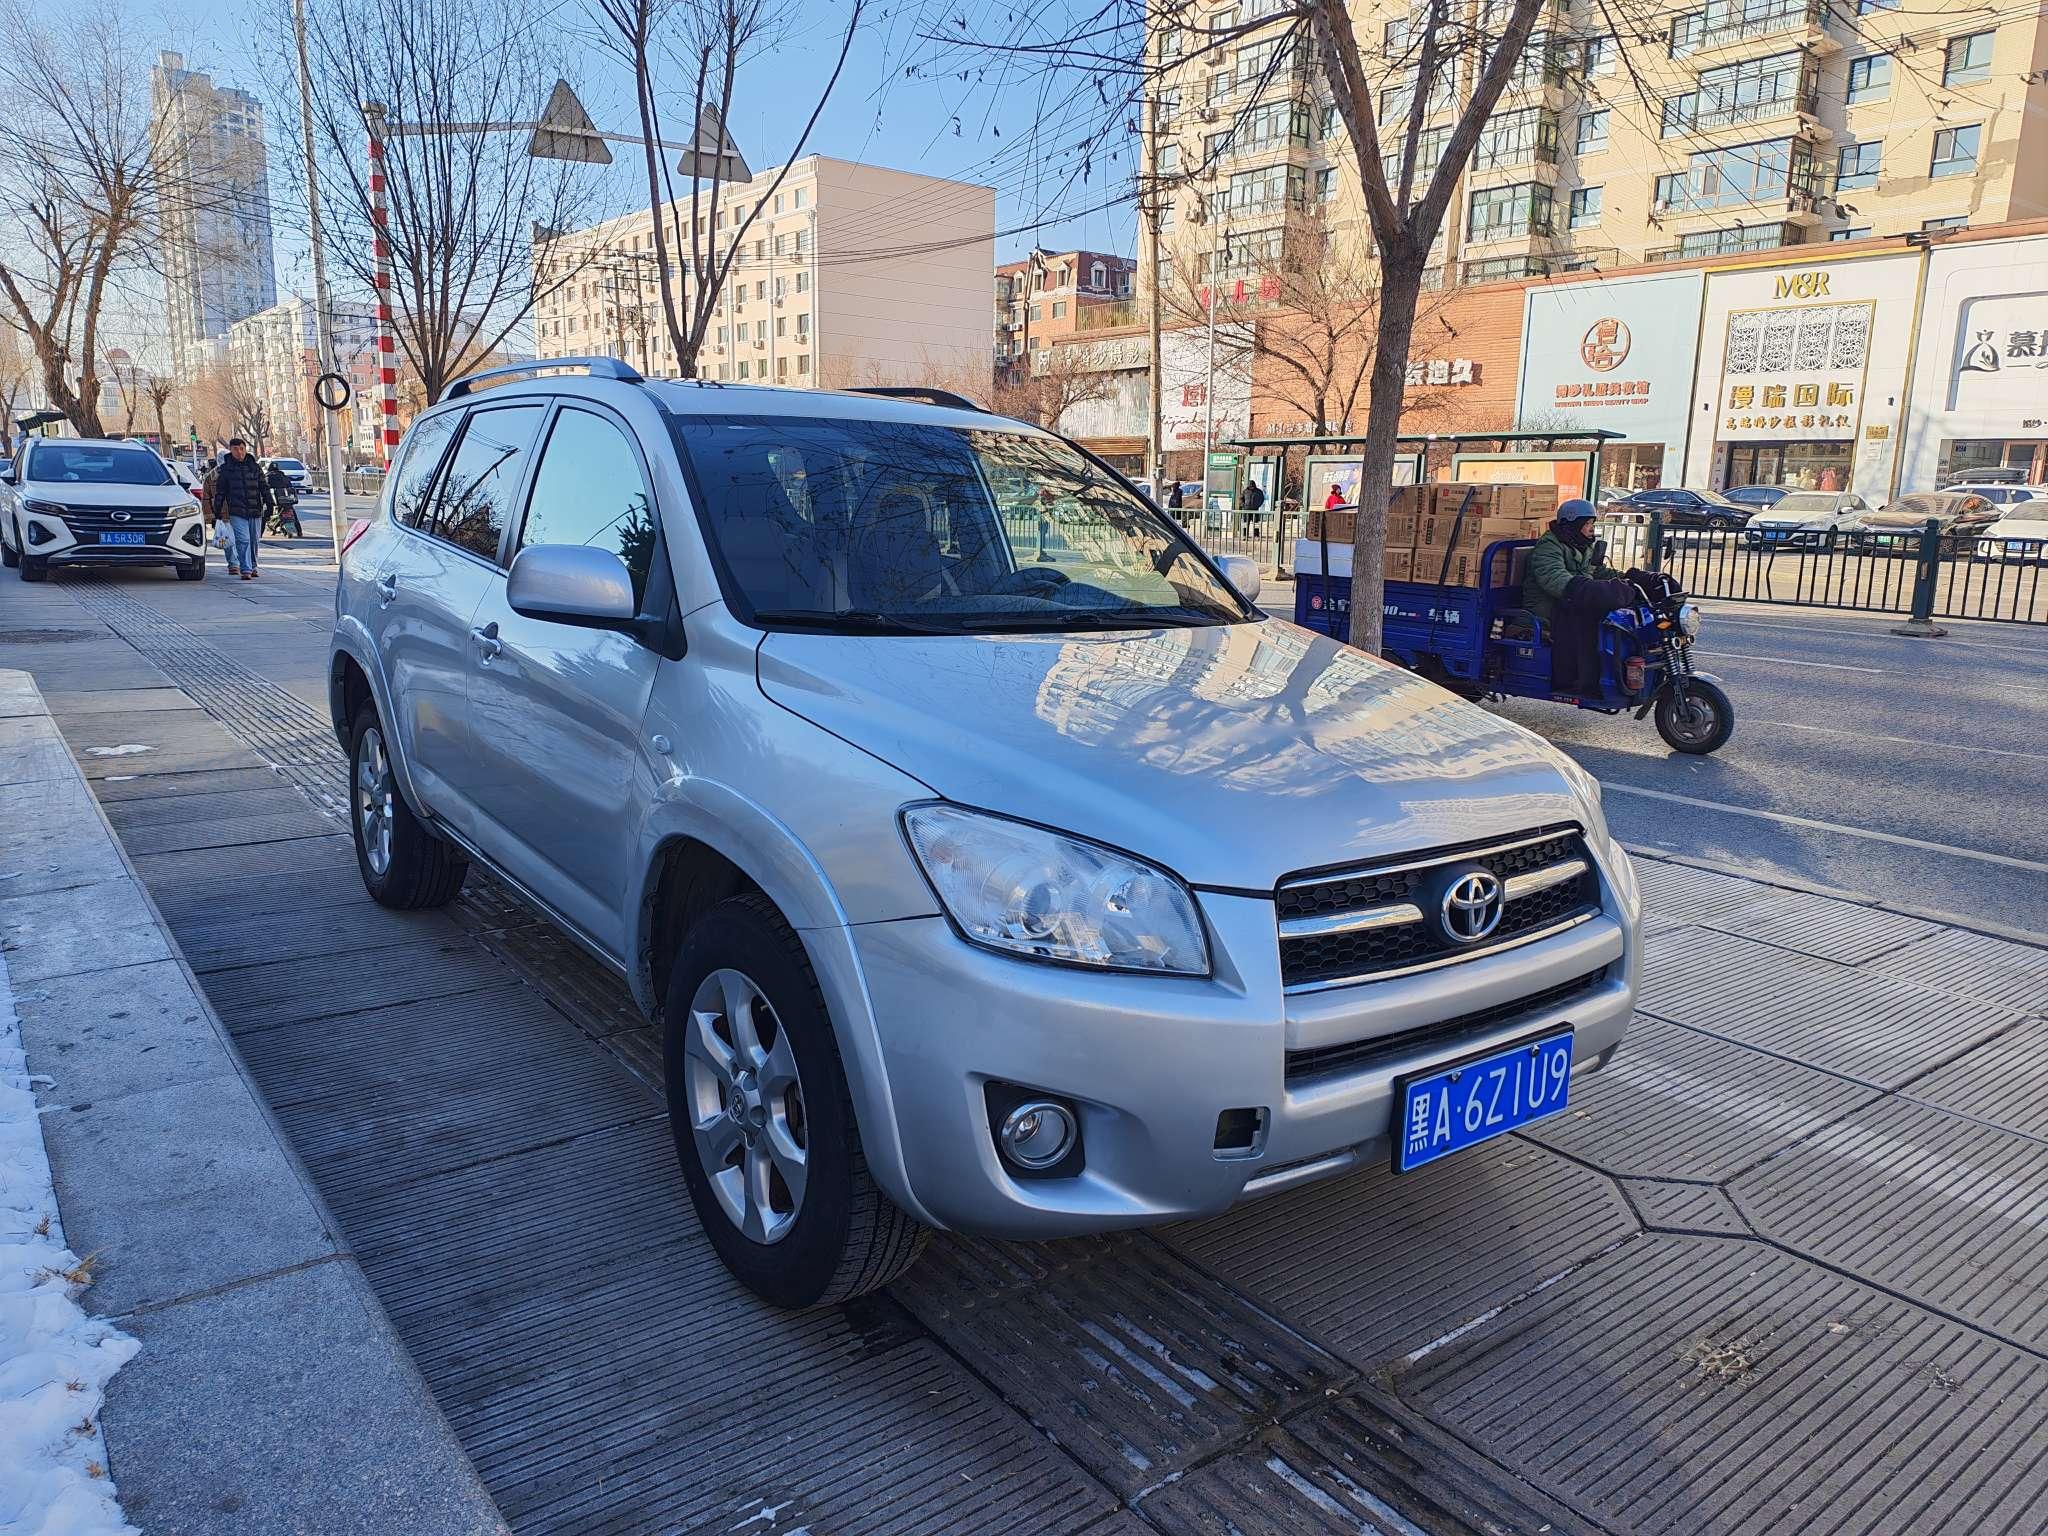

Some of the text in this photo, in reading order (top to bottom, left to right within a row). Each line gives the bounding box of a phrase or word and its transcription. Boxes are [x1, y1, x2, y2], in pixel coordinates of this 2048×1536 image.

[1772, 271, 1830, 299] M&R
[1729, 382, 1854, 409] 漫瑞国际
